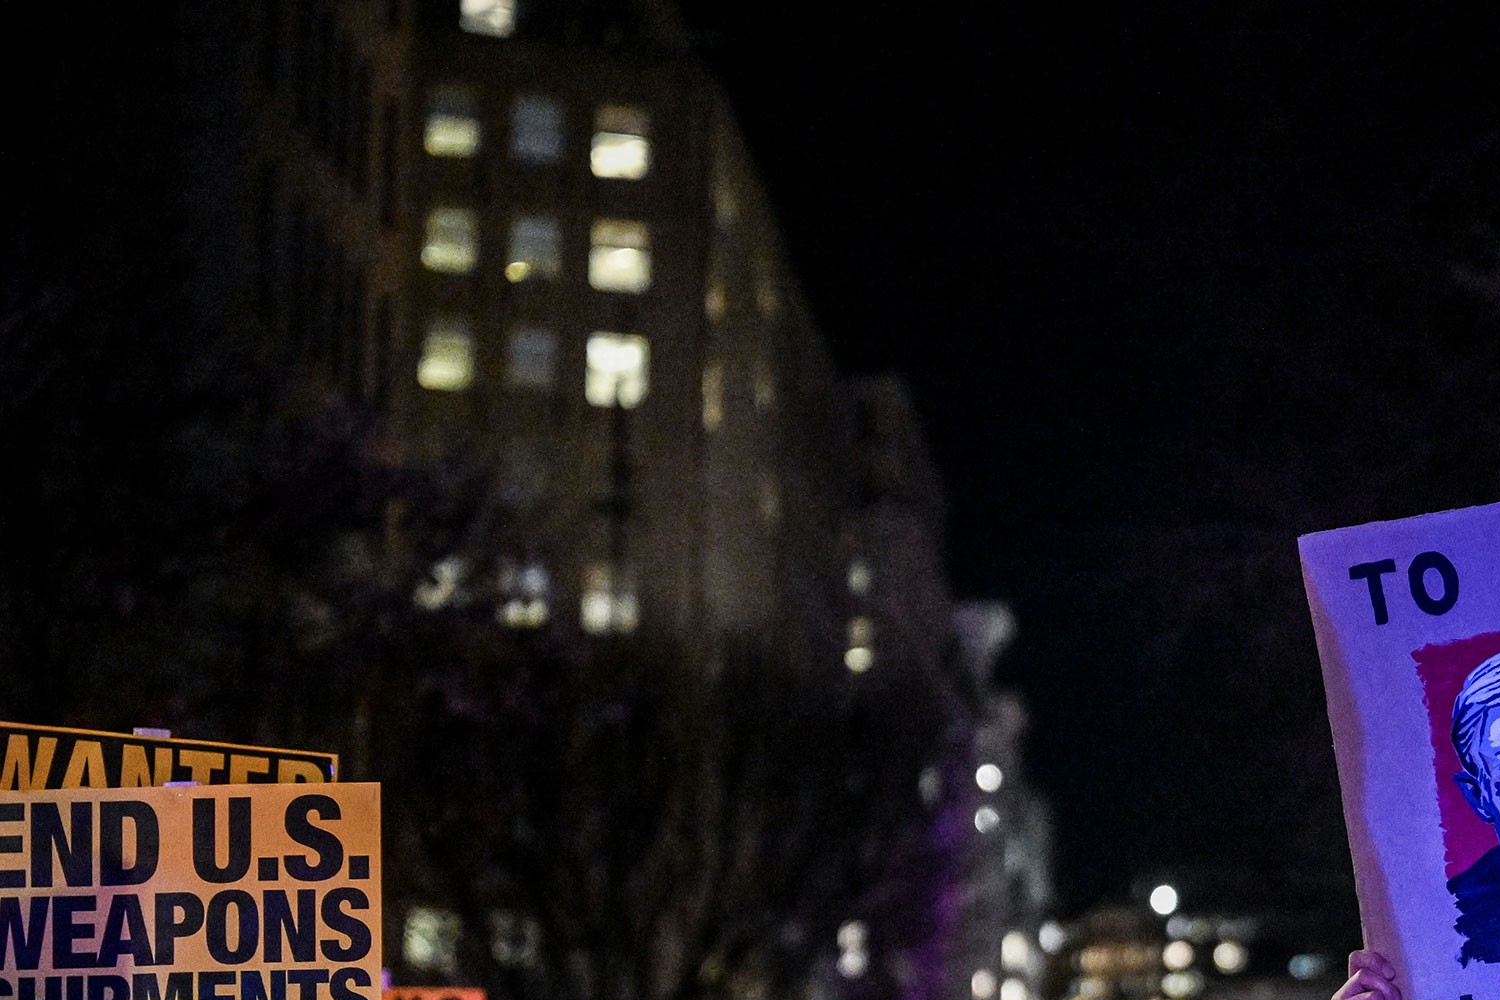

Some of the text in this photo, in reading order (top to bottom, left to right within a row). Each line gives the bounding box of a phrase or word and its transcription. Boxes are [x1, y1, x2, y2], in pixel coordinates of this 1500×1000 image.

[1349, 550, 1459, 625] TO
[192, 794, 370, 883] U.S.
[0, 886, 372, 970] WEAPONS
